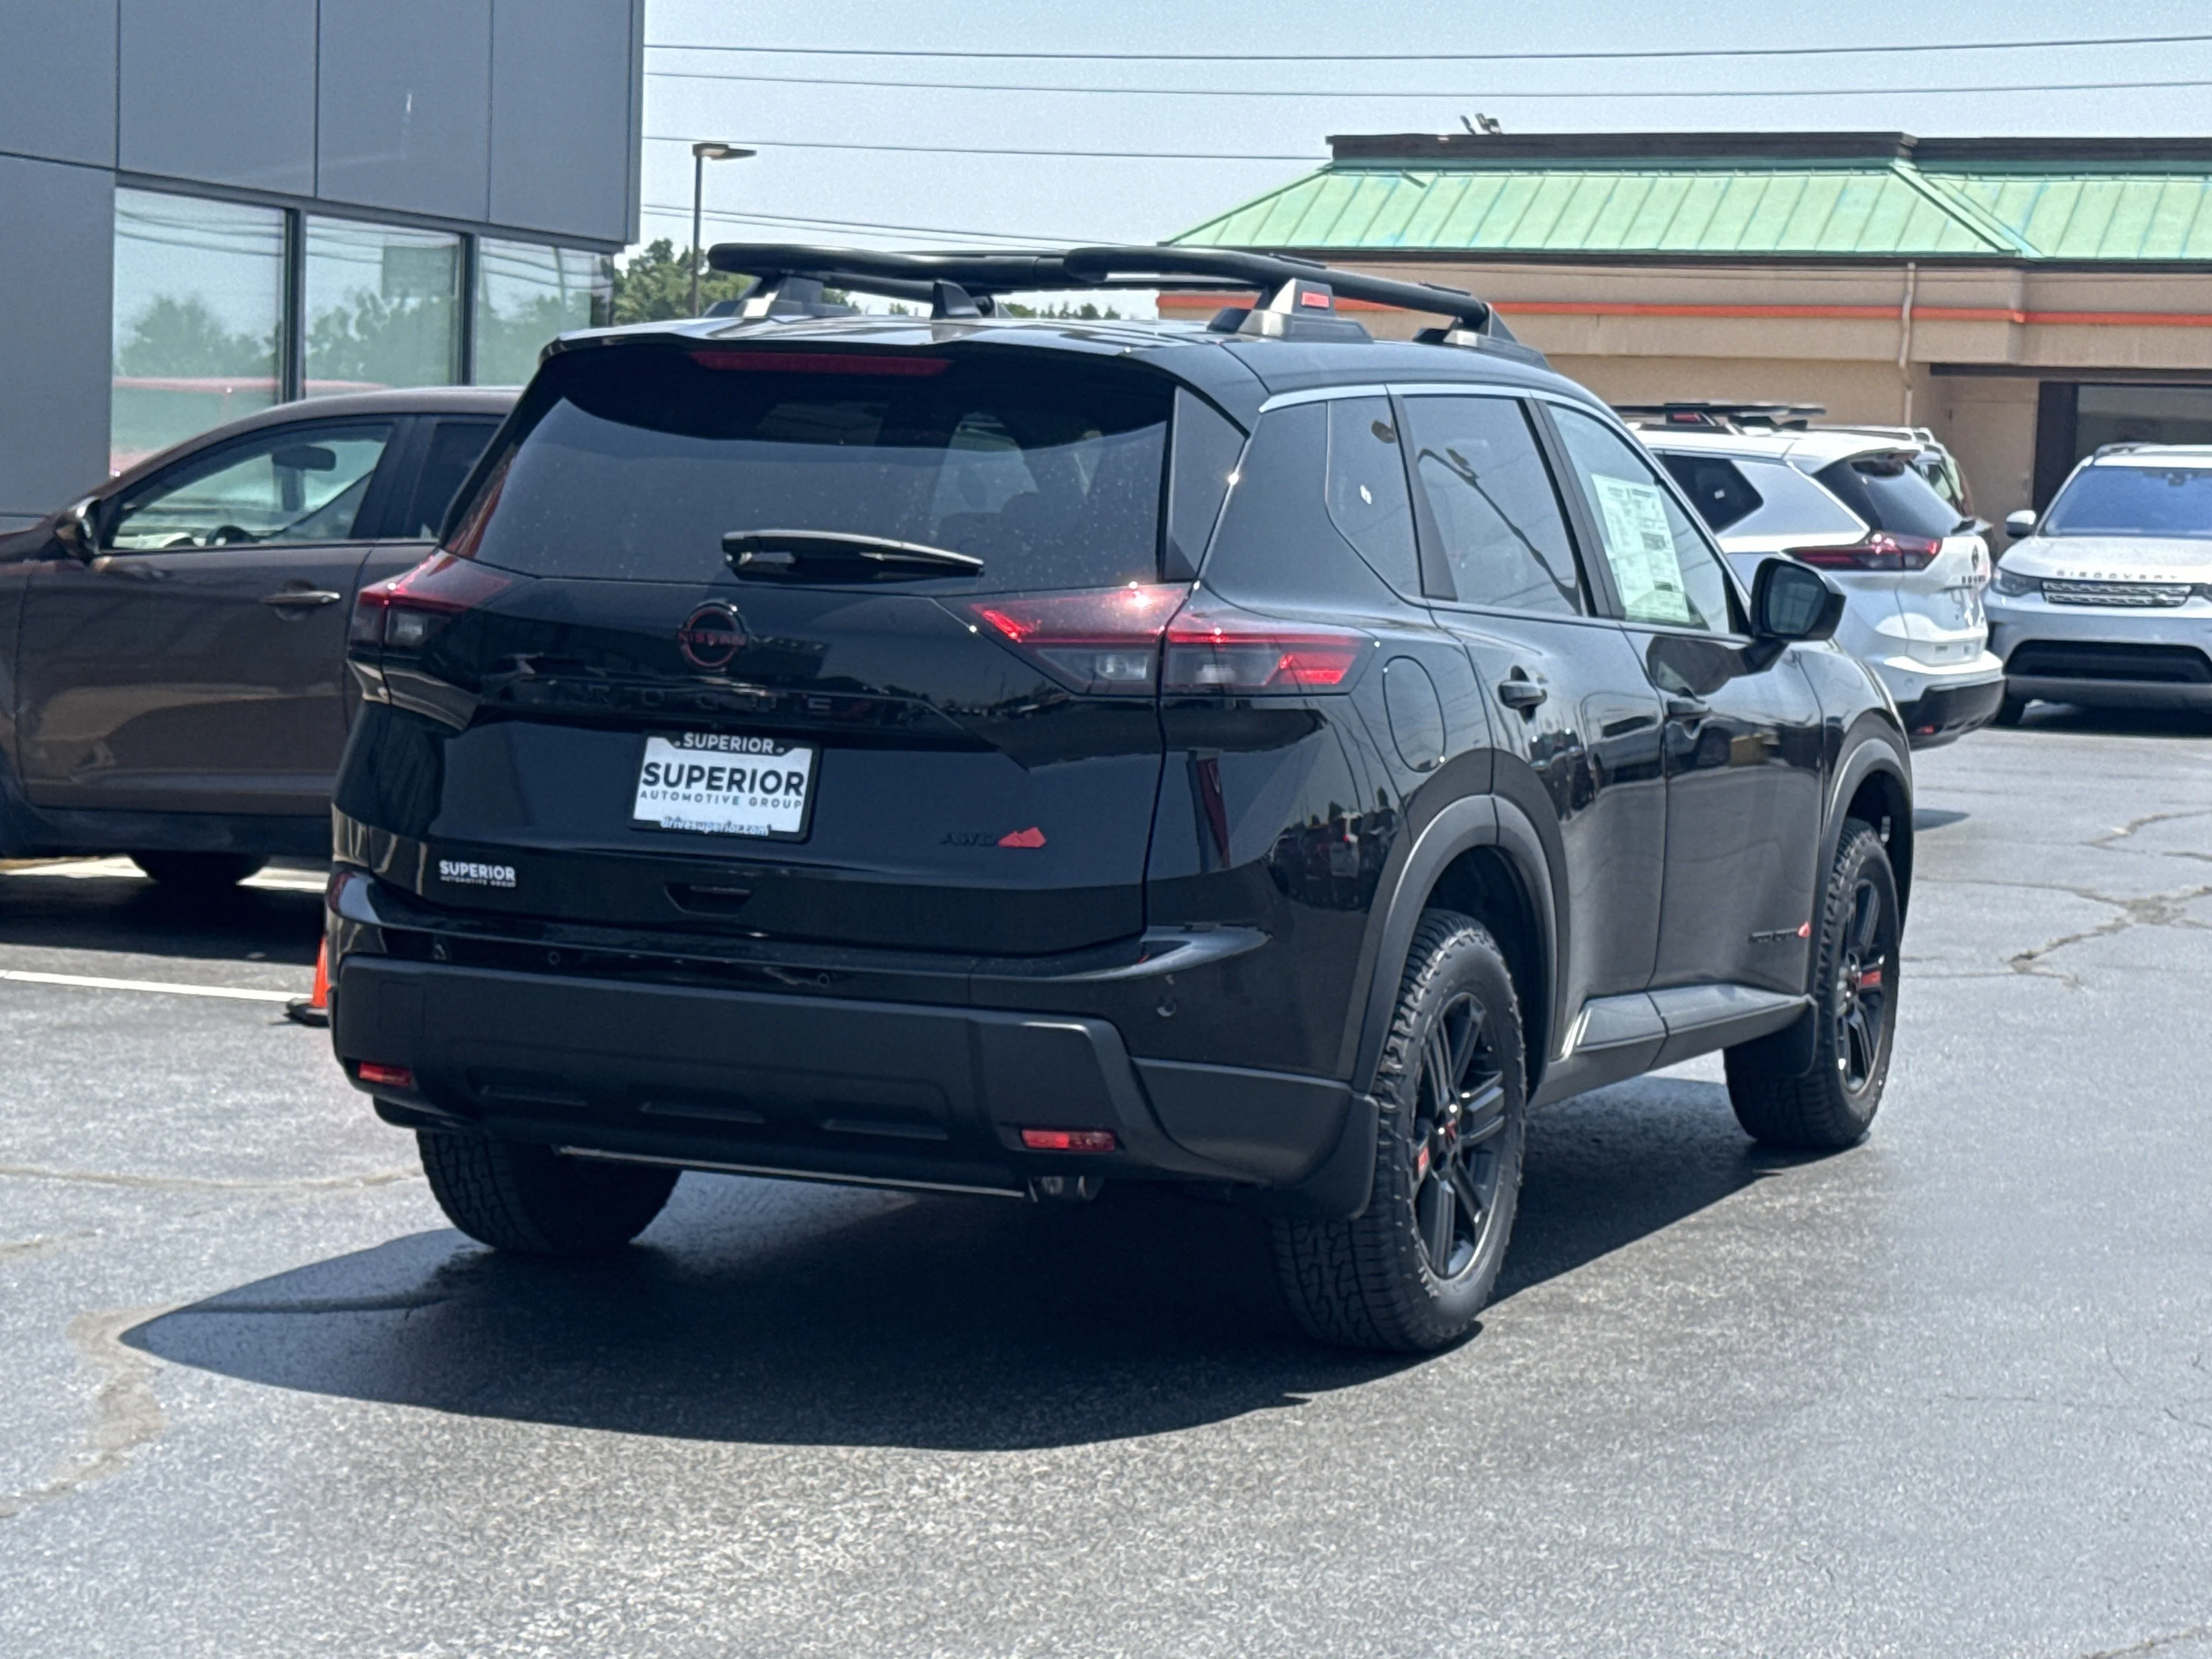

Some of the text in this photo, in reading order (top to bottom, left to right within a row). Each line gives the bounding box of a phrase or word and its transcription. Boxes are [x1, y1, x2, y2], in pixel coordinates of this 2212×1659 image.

[683, 732, 775, 754] SUPERIOR
[641, 761, 805, 796] SUPERIOR
[639, 789, 802, 809] AUTOMOTIVE GROUP
[439, 859, 515, 881] SUPERIOR
